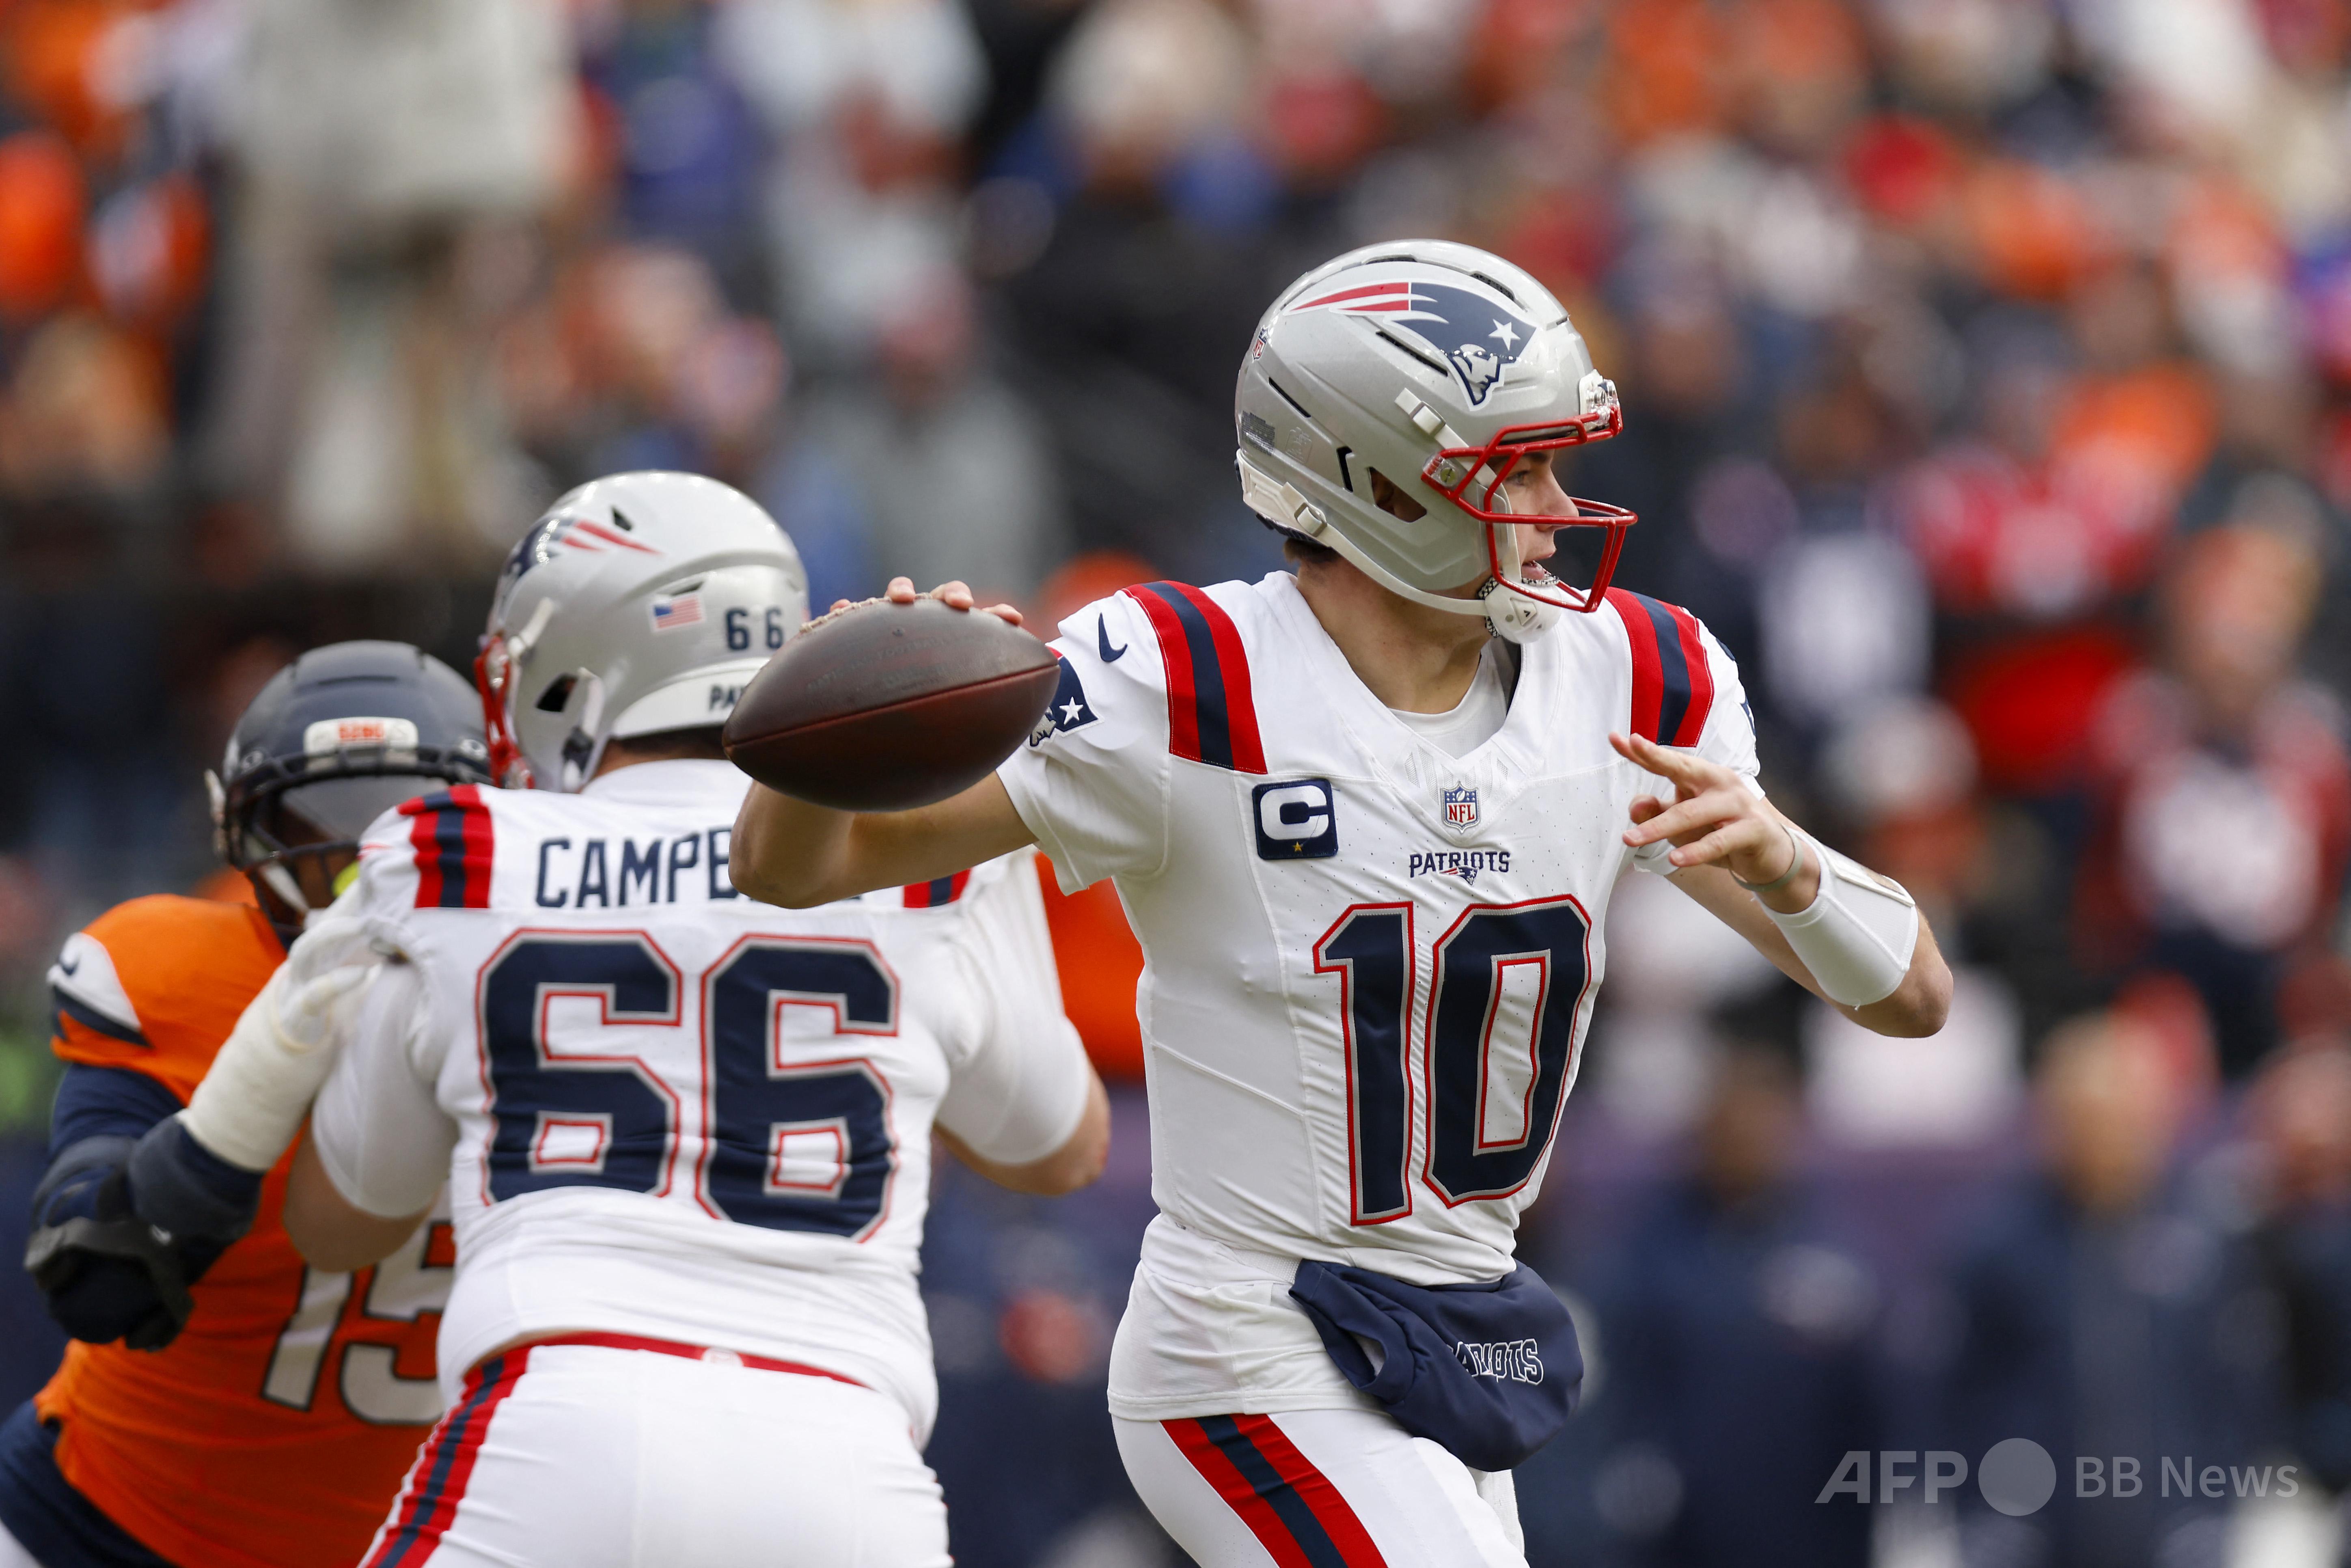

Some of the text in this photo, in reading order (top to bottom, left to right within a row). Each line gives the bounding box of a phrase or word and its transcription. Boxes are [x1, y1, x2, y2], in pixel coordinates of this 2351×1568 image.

[725, 606, 784, 651] 66
[1260, 785, 1329, 840] C
[1448, 804, 1475, 824] NFL
[535, 826, 861, 908] CAMPB
[1409, 851, 1511, 878] PATRIOTS
[475, 927, 900, 1243] 66
[1313, 894, 1592, 1226] 10
